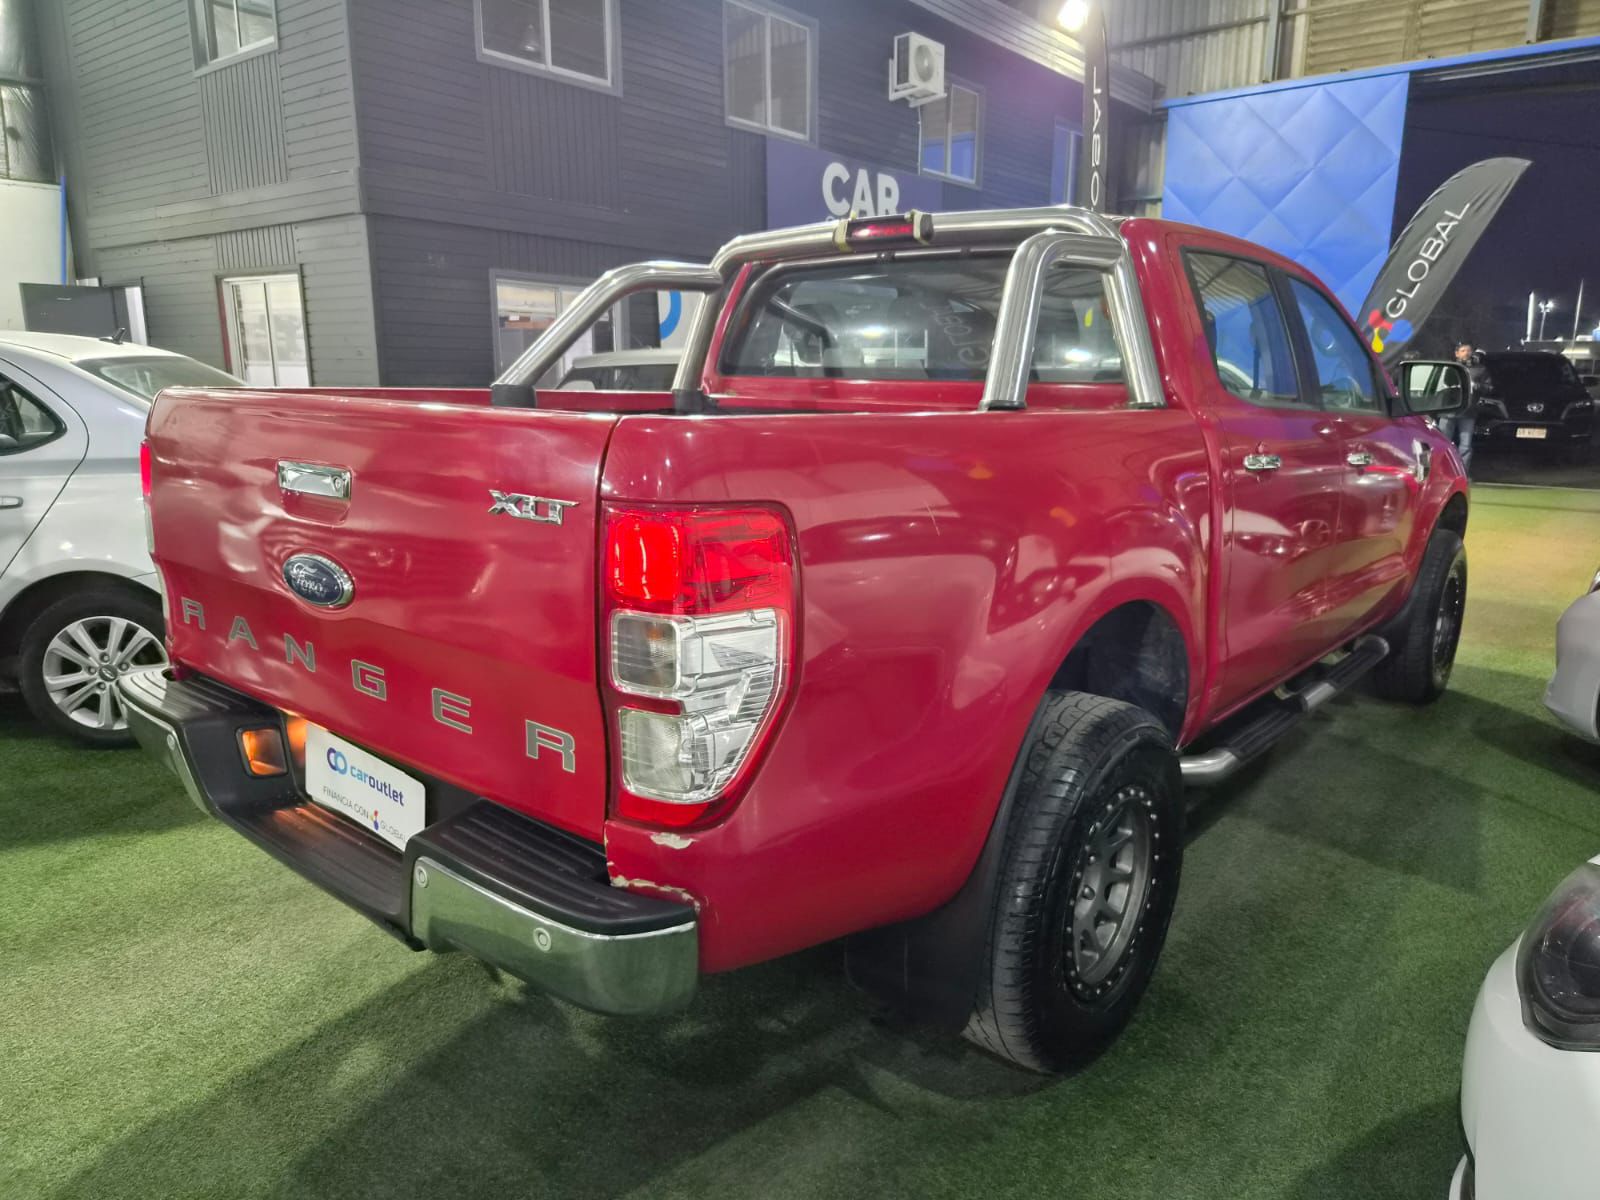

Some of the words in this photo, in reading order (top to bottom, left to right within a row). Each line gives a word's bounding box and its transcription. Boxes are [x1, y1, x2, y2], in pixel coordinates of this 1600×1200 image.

[822, 162, 900, 217] CAR
[1386, 203, 1470, 318] GLOBAL
[488, 489, 580, 527] XLT
[180, 596, 576, 773] RANGER
[323, 785, 353, 810] FINANCIA
[354, 803, 369, 820] CON
[350, 764, 404, 807] caroutlet
